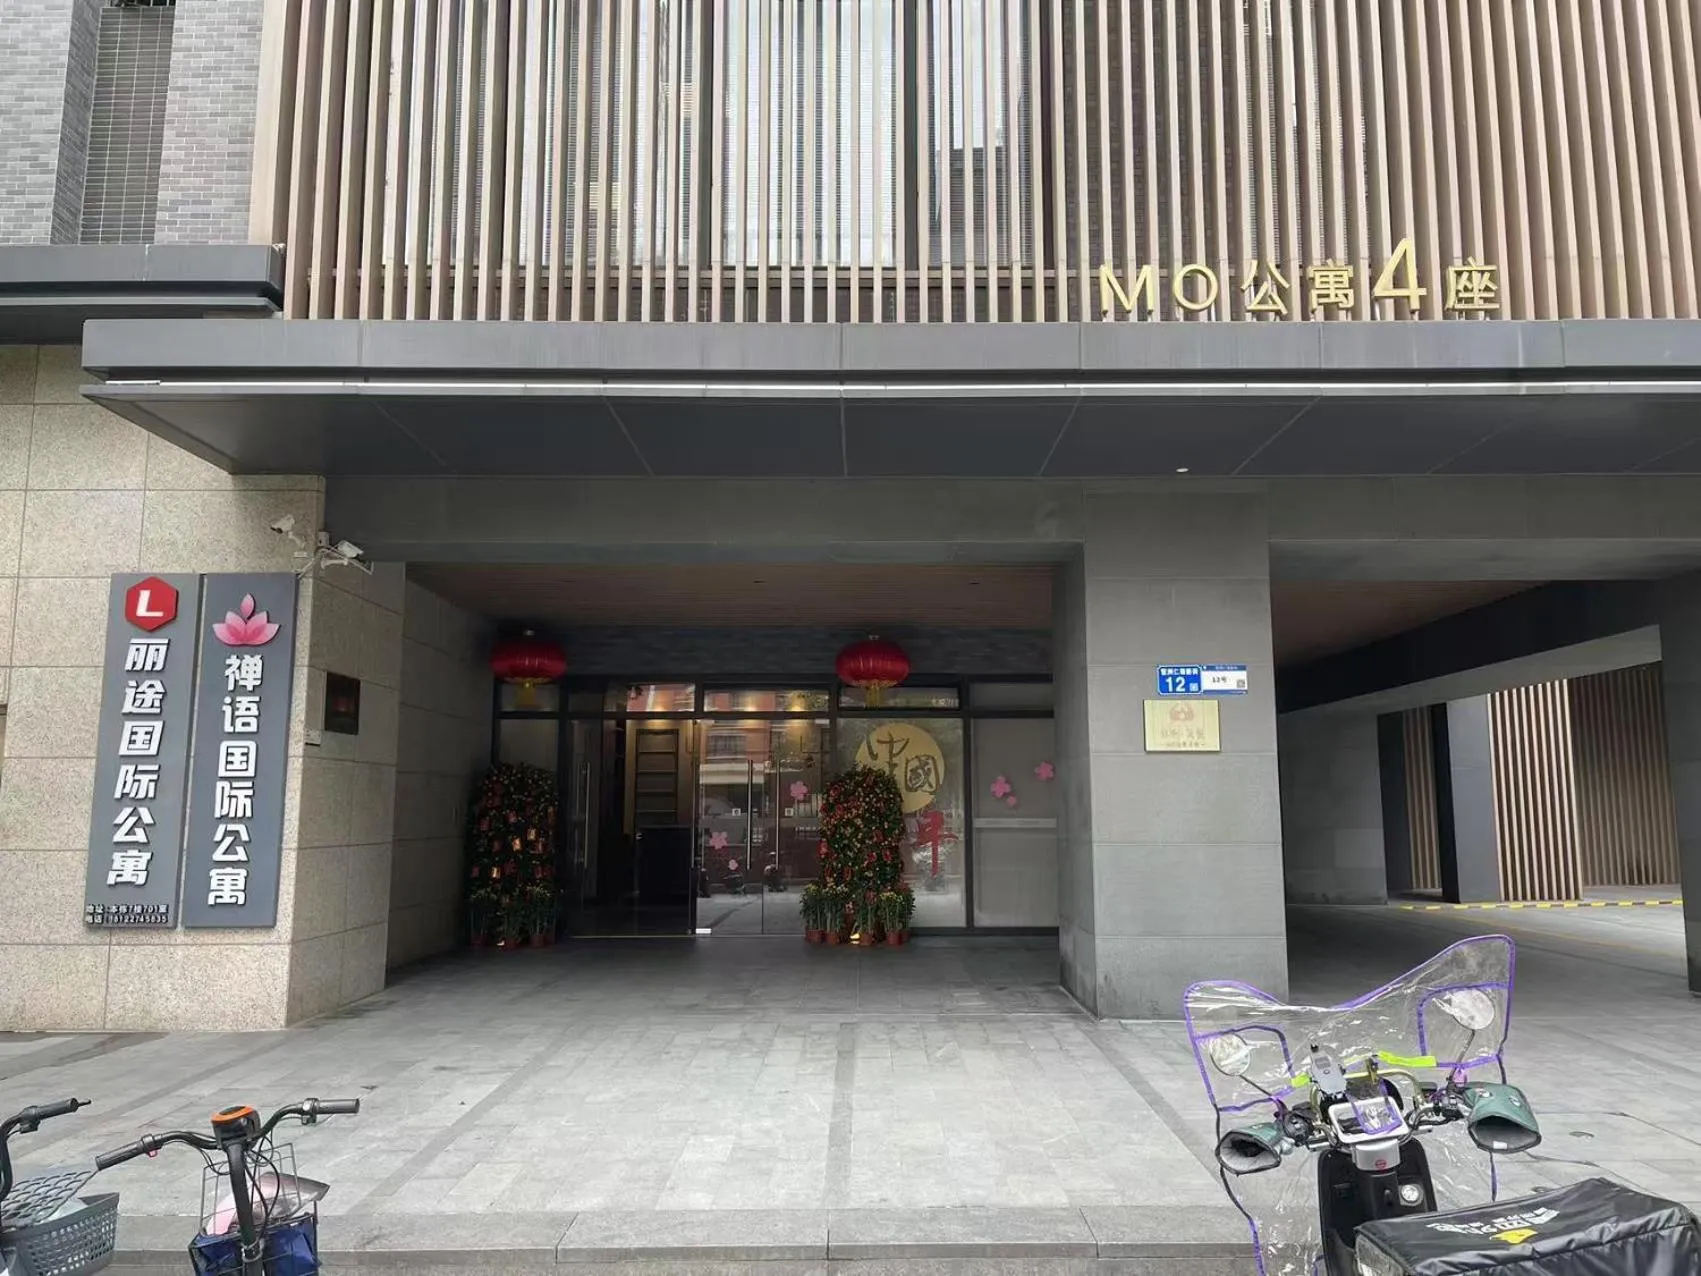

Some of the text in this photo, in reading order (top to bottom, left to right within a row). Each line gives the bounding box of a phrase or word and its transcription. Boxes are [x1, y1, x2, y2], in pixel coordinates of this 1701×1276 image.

[1099, 237, 1499, 314] MO公寓4座
[135, 589, 165, 618] L
[106, 637, 172, 887] 丽途国际公寓
[207, 653, 265, 906] 禅语国际公寓
